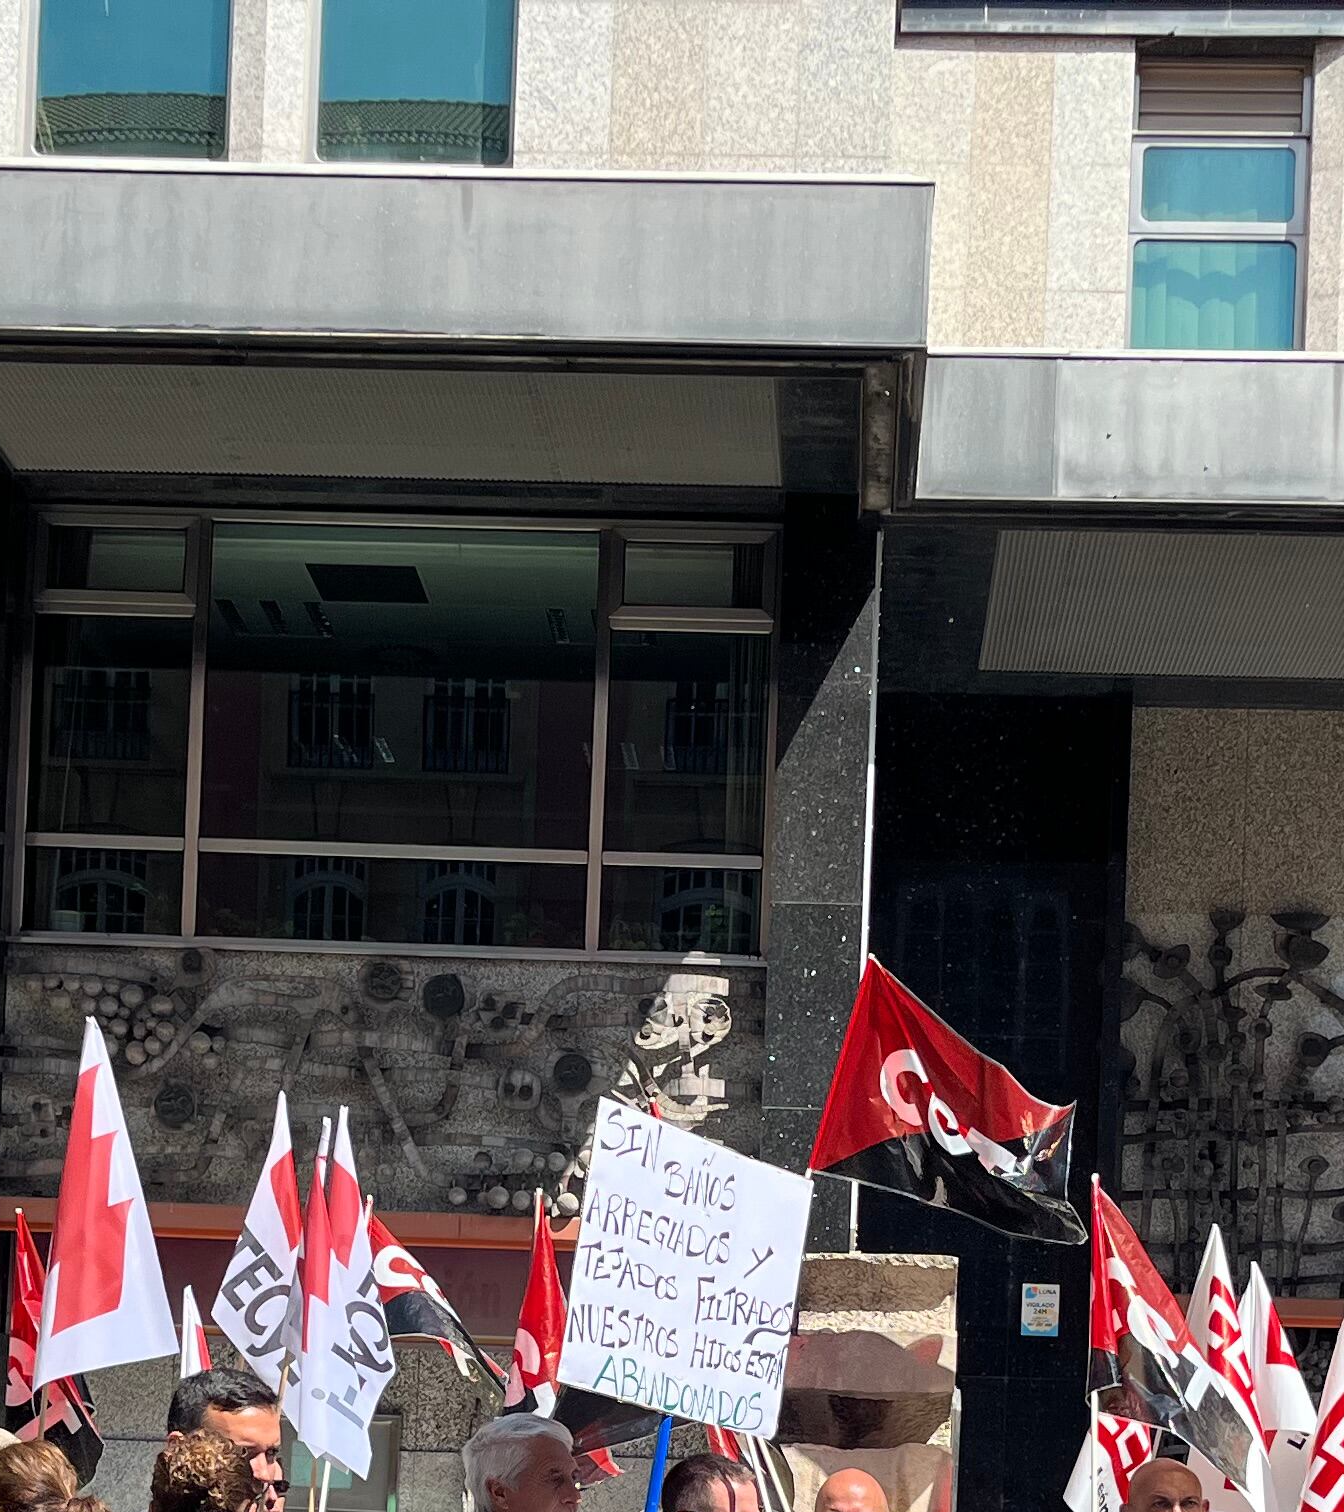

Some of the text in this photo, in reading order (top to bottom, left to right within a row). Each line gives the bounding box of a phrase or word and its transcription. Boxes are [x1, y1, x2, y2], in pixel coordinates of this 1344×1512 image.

[600, 1107, 736, 1212] SIN BAÑOS
[580, 1241, 794, 1332] TEJADOS FILTRADOS
[744, 1246, 774, 1278] Y
[567, 1303, 679, 1359] NUESTROS
[690, 1331, 742, 1374] HIJOS
[592, 1354, 764, 1431] ABANDONADOS
